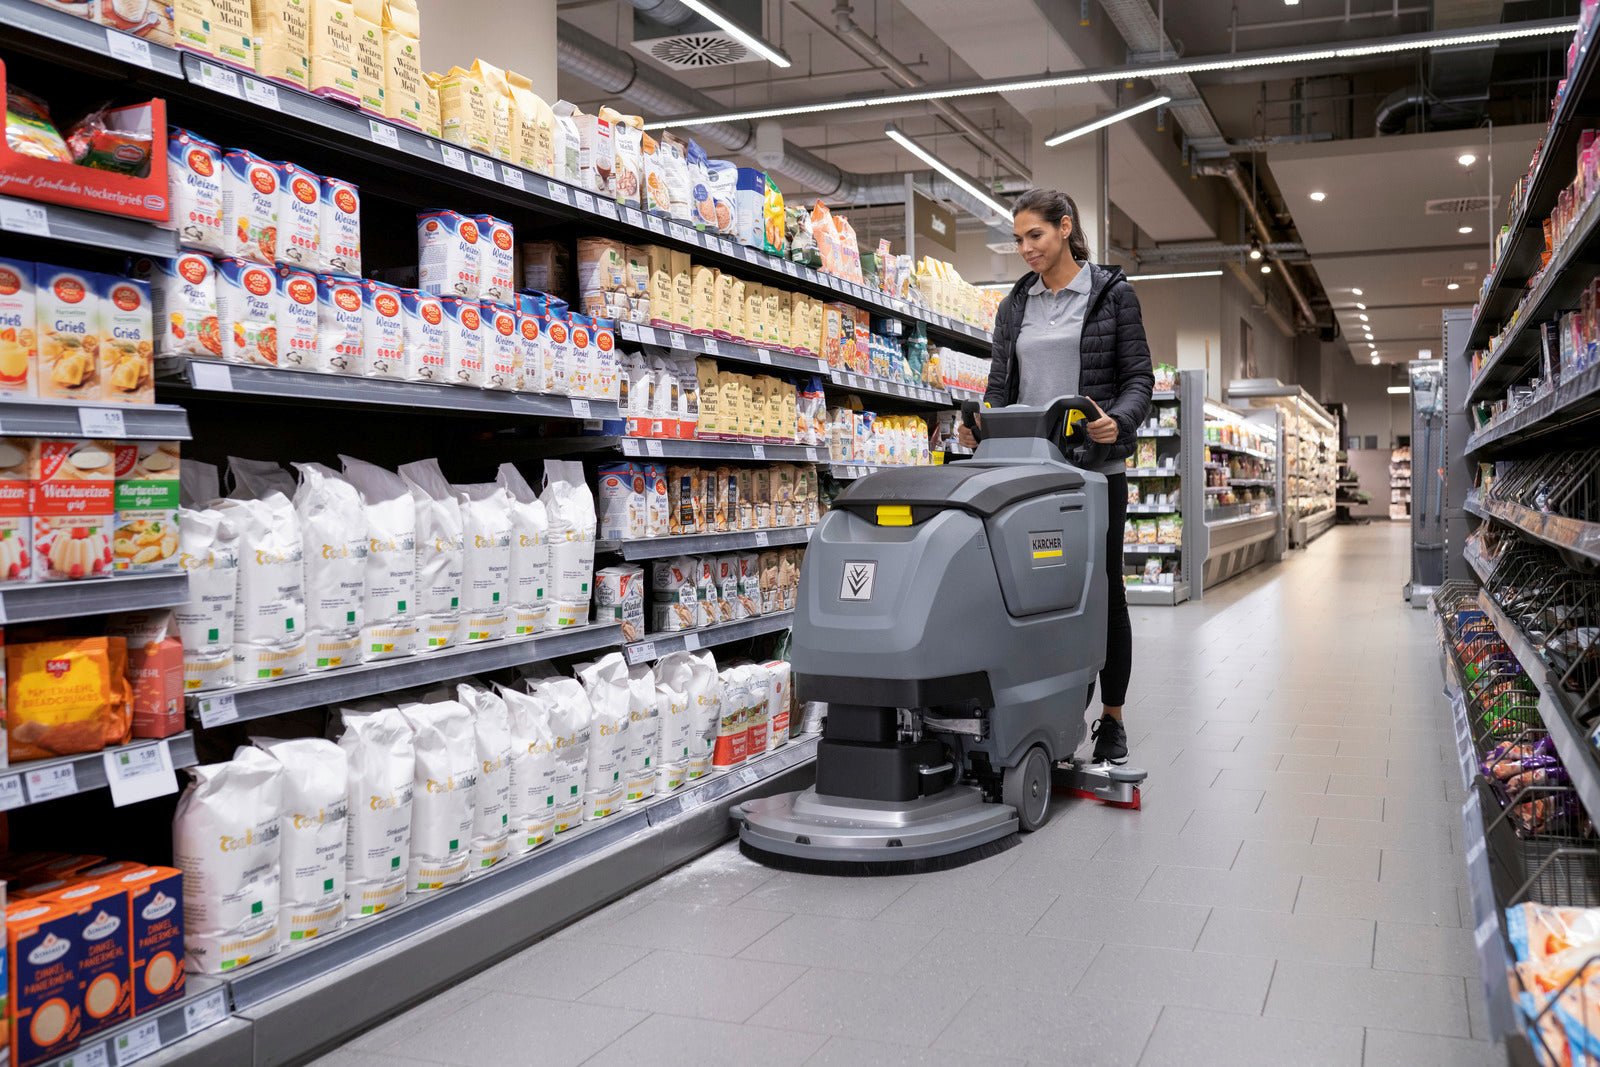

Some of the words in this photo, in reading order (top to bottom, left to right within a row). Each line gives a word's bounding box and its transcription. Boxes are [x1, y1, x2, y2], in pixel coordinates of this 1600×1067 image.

[211, 0, 249, 18] Vollkorn
[220, 12, 242, 28] Mehl
[283, 11, 307, 29] Dinkel
[288, 24, 305, 40] Mehl
[327, 25, 352, 44] Dinkel
[358, 42, 382, 61] Weizen
[363, 65, 380, 80] Mehl
[396, 57, 419, 75] Weizen
[393, 67, 421, 85] Vollkorn
[401, 79, 416, 94] Mehl
[187, 174, 219, 192] Weizen
[196, 189, 214, 199] Mehl
[252, 192, 272, 208] Pizza
[291, 200, 318, 218] Weizen
[334, 211, 359, 227] Weizen
[459, 241, 481, 255] Weizen
[492, 247, 513, 262] Weizen
[246, 295, 269, 309] Pizza
[250, 308, 267, 318] Mehl
[288, 303, 316, 317] Weizen
[0, 314, 22, 327] rieß
[336, 311, 362, 326] Weizen
[376, 316, 400, 330] Weizen
[55, 319, 86, 334] Grieß
[113, 326, 141, 340] Grieß
[119, 484, 169, 497] Hartweizen
[147, 919, 172, 935] DINKEL
[35, 962, 64, 979] DINKEL
